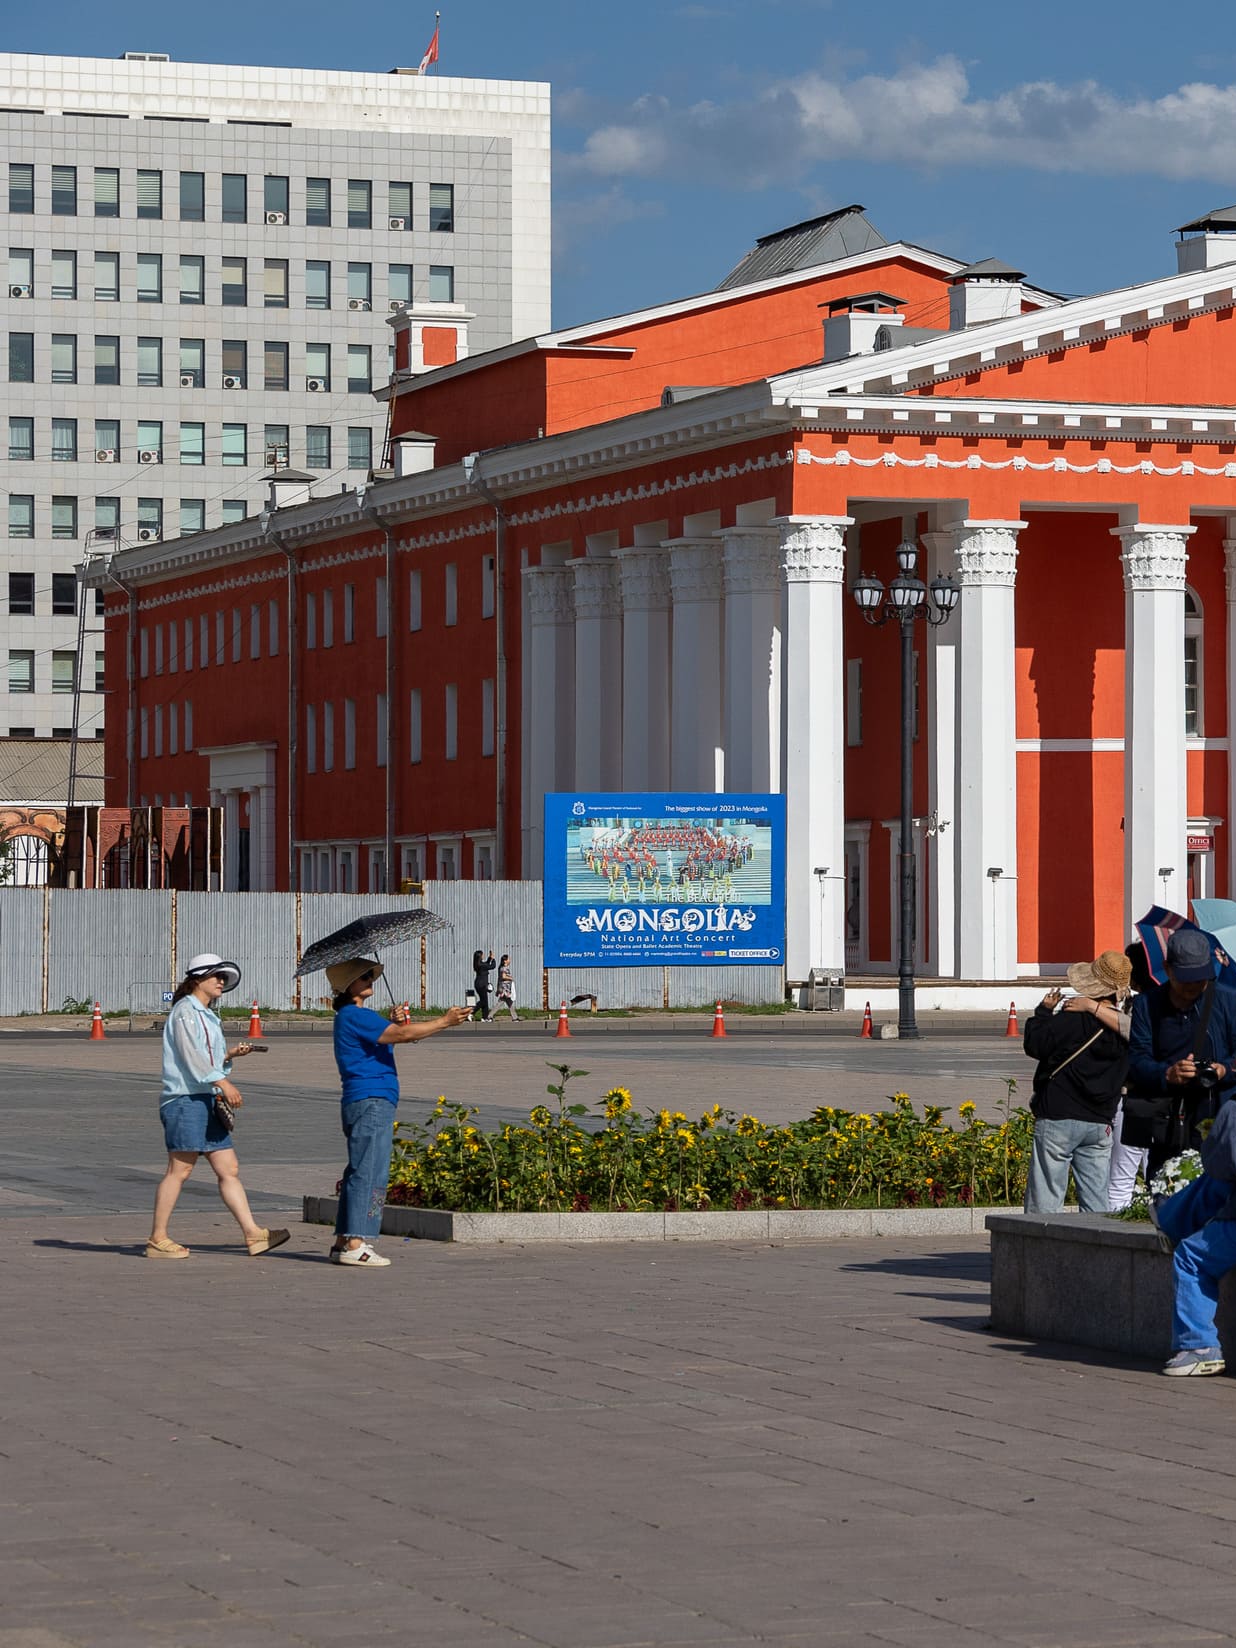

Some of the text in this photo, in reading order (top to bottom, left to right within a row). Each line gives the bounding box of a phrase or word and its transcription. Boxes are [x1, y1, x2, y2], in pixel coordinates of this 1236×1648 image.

[675, 805, 696, 813] biggest
[719, 804, 736, 812] 2023
[742, 805, 768, 813] Mongolia
[665, 893, 685, 903] The
[576, 904, 756, 932] MONGOLIA
[601, 934, 736, 942] National Art Concert
